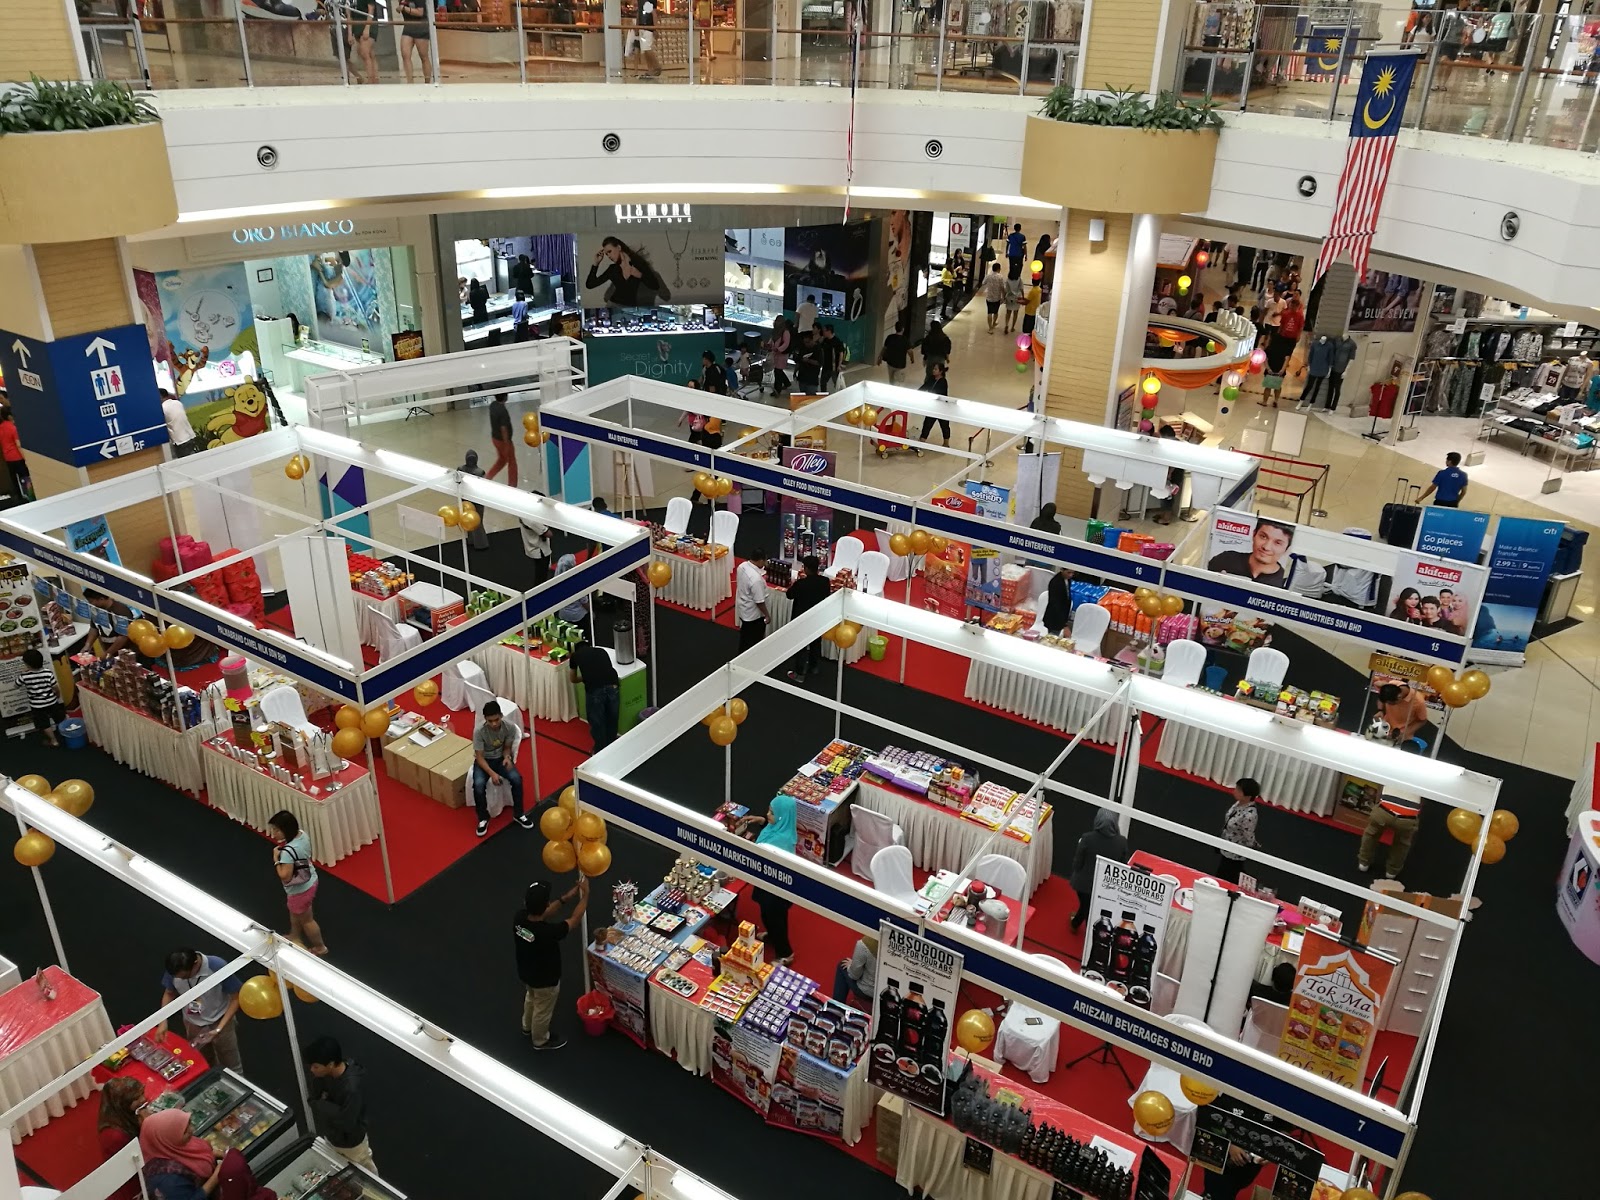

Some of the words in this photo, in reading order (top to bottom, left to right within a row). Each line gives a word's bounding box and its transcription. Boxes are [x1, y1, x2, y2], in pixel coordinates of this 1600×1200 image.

[1549, 0, 1571, 50] ALE
[232, 227, 275, 244] ORO
[1364, 307, 1385, 319] BLUE
[1387, 308, 1415, 319] SEVEN
[635, 360, 693, 379] Dignity
[134, 440, 145, 451] 2F
[617, 435, 638, 447] ENTERPRISE
[694, 453, 700, 462] 18
[791, 452, 828, 474] Olley
[782, 477, 796, 487] OLLEY
[796, 481, 807, 491] FOOD
[807, 484, 832, 497] INDUSTRIES
[890, 504, 897, 513] 17
[1009, 535, 1025, 547] RAFIQ
[1025, 539, 1055, 554] ENTERPRISE
[1421, 544, 1451, 554] sooner.
[1424, 534, 1436, 542] Go
[1436, 537, 1463, 547] places
[1135, 566, 1142, 576] 16
[1247, 596, 1276, 611] AKIFCAFE
[1276, 604, 1299, 618] COFFEE
[1299, 610, 1335, 627] INDUSTRIES
[1334, 618, 1348, 630] SDN
[1349, 622, 1362, 633] BHD
[1431, 642, 1440, 651] 15
[677, 827, 698, 843] MUNIF
[698, 836, 722, 855] HIJJAZ
[722, 846, 762, 872] MARKETING
[763, 864, 778, 880] SDN
[778, 871, 793, 886] BHD
[1103, 875, 1120, 887] JUICE
[1120, 880, 1133, 891] FOR
[1134, 884, 1151, 897] YOUR
[1150, 890, 1165, 902] ABS
[1104, 864, 1166, 895] ABSOGOOD
[888, 929, 954, 967] ABSOGOOD
[888, 940, 906, 953] JUICE
[906, 947, 919, 959] FOR
[920, 953, 938, 968] YOUR
[938, 962, 953, 975] ABS
[1301, 988, 1317, 1000] Rasa
[1344, 1005, 1371, 1020] Sebenar
[1306, 978, 1337, 1004] Tok
[1342, 993, 1372, 1013] Ma
[1073, 999, 1114, 1025] ARIEZAM
[1114, 1018, 1169, 1049] BEVERAGES
[1170, 1041, 1191, 1059] SDN
[1192, 1050, 1214, 1068] BHD
[1357, 1119, 1366, 1132] 7
